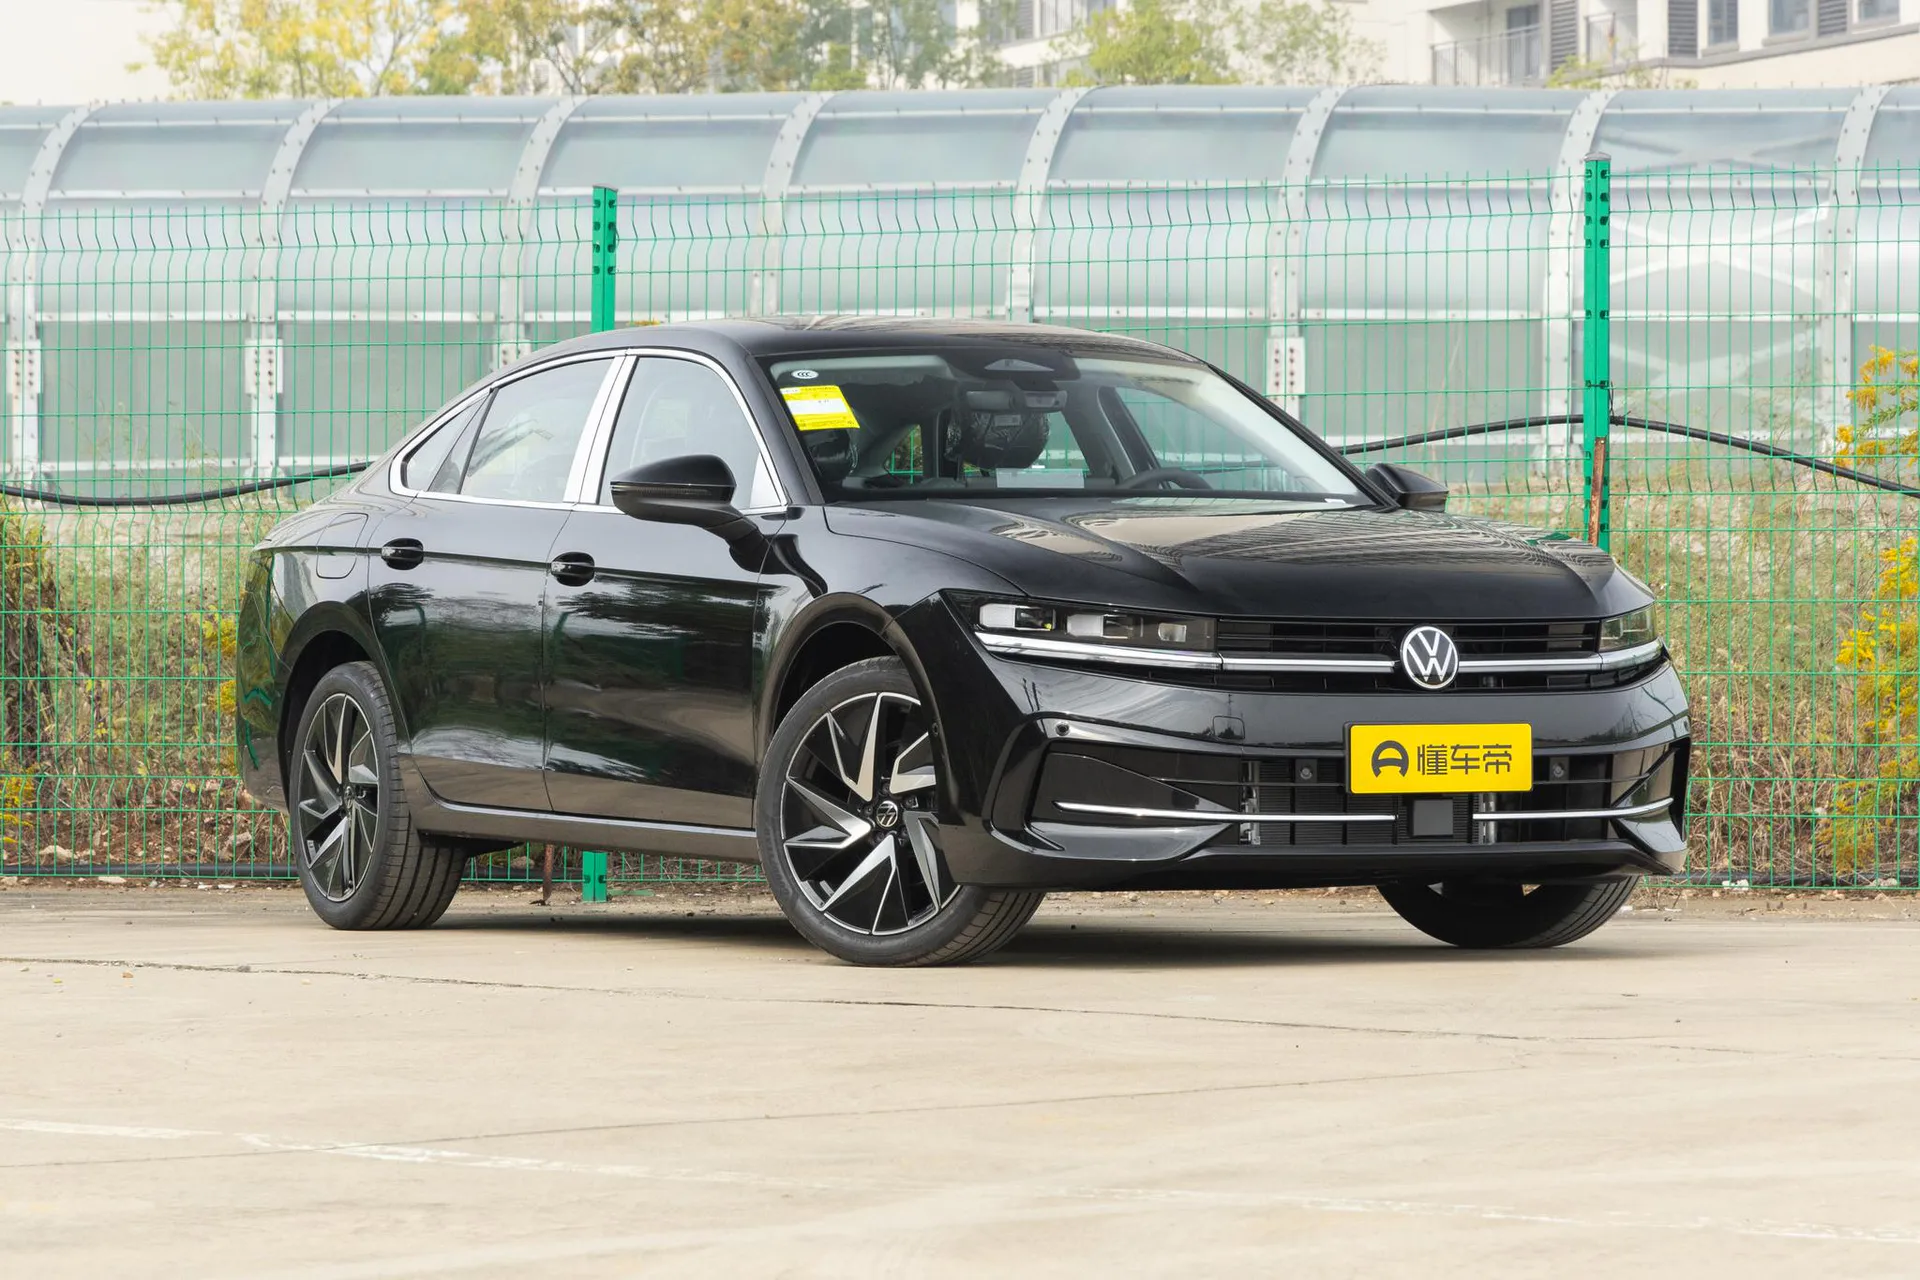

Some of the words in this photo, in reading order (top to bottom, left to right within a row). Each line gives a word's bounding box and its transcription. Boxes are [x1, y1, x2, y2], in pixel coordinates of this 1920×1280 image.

[1405, 629, 1455, 684] VW
[1416, 743, 1512, 775] 懂车帝
